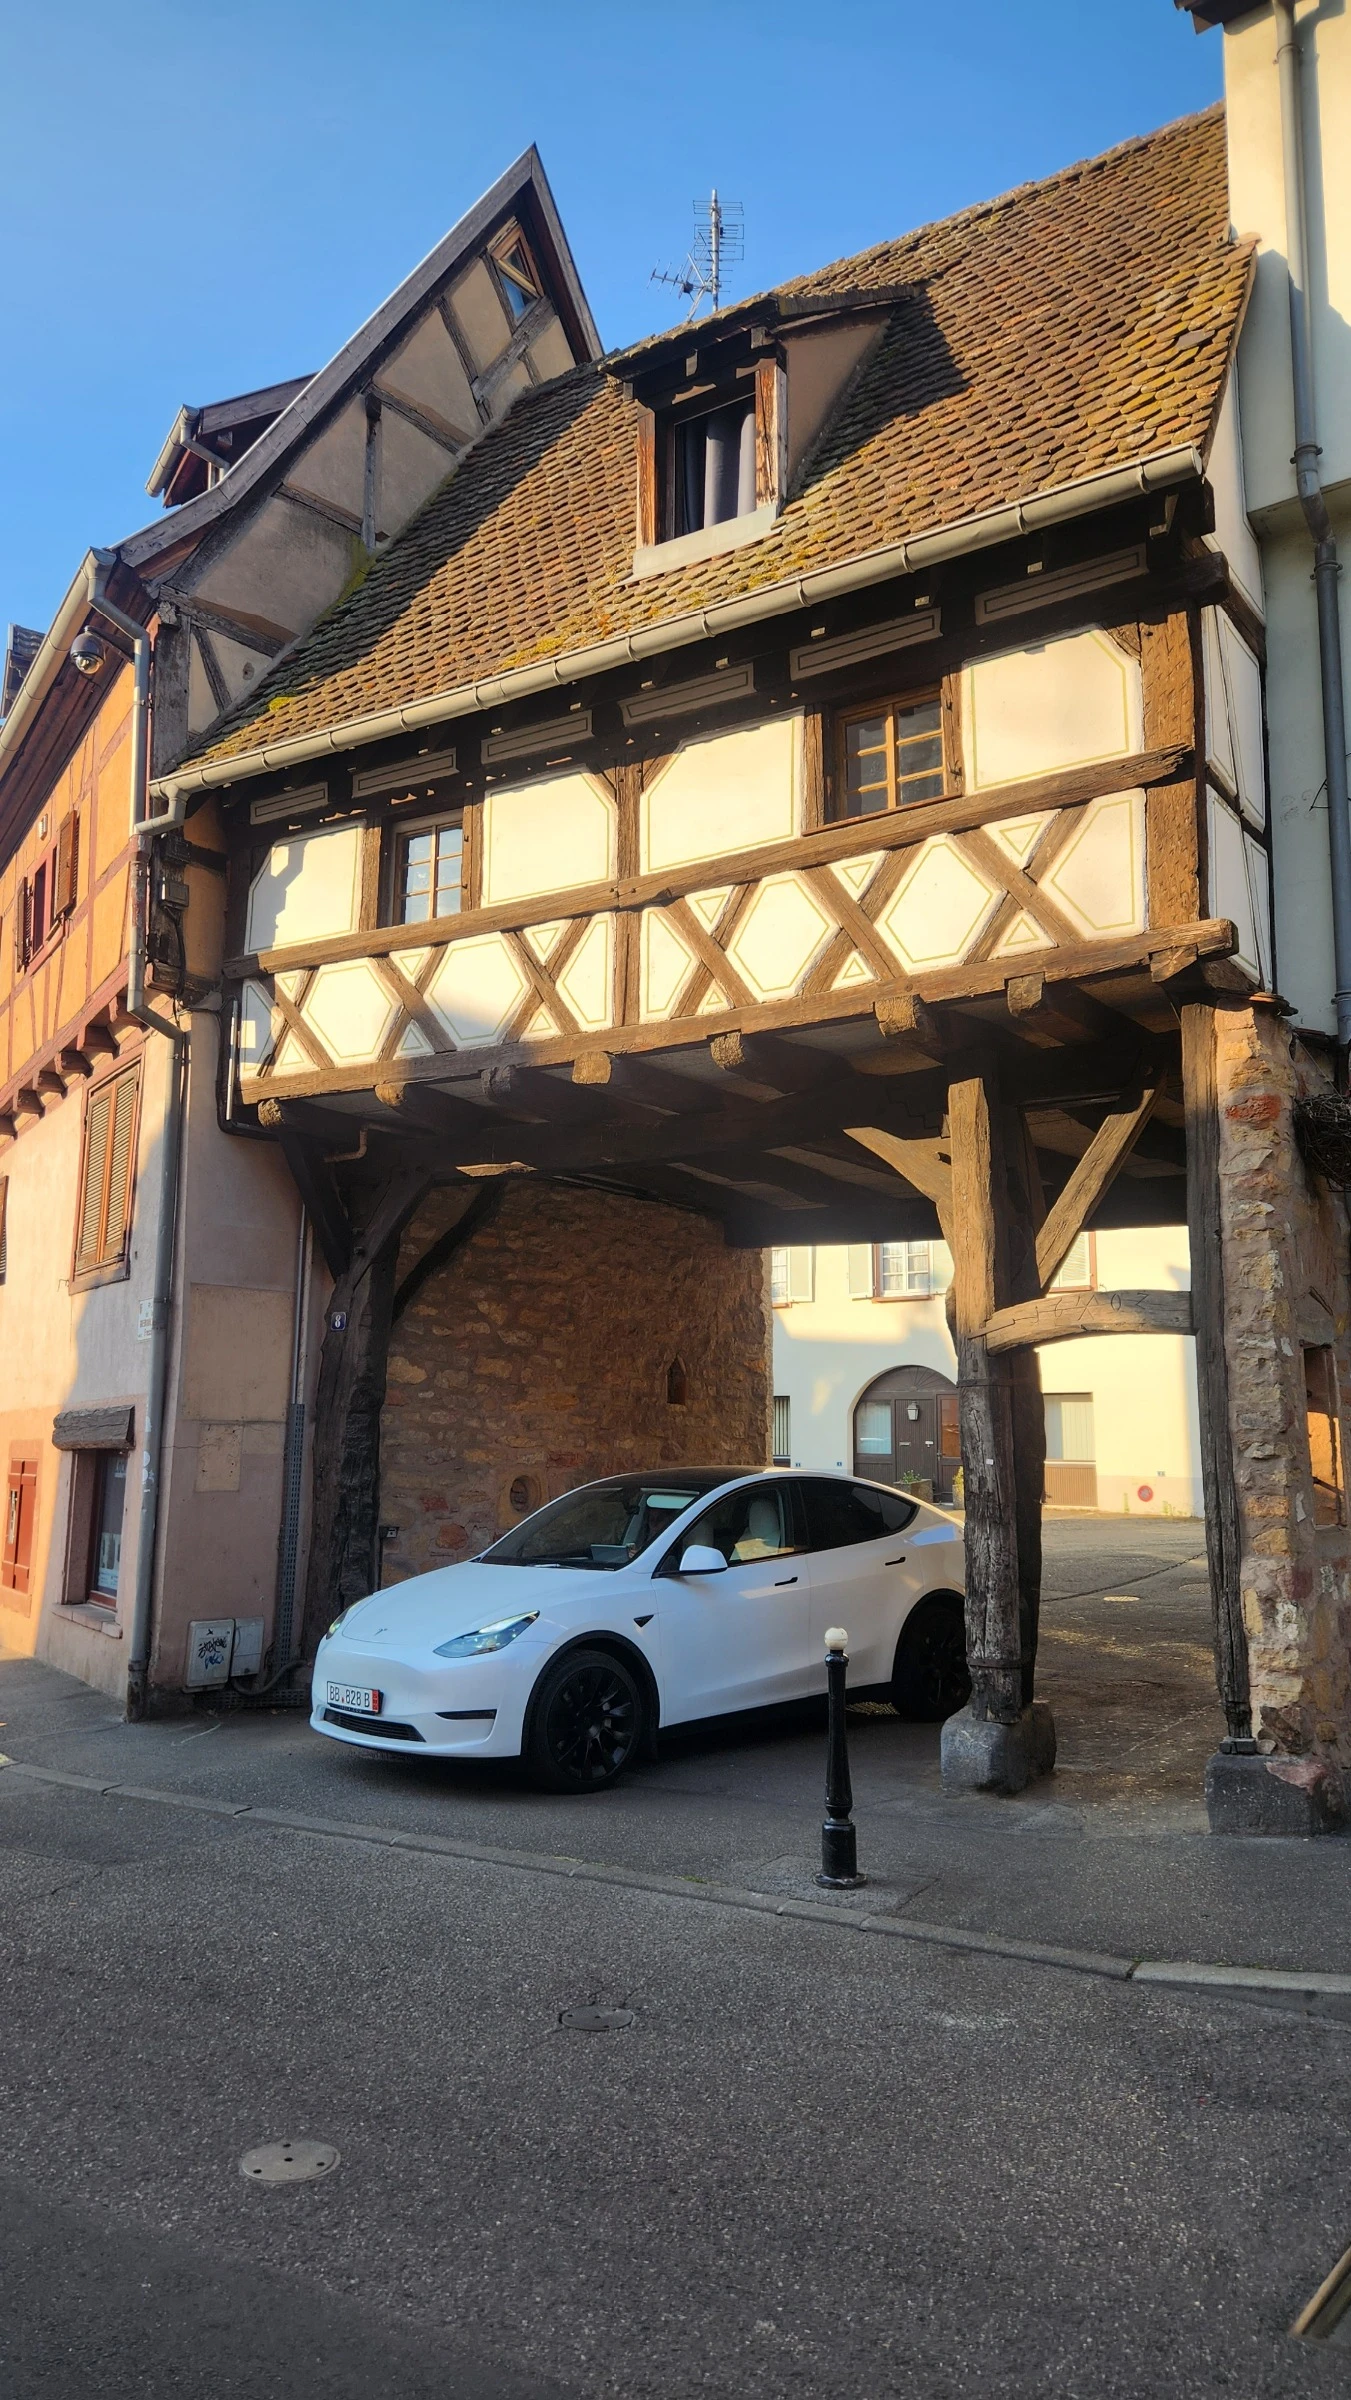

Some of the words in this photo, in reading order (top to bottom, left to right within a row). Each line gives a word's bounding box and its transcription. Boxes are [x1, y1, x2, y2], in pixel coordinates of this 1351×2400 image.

[334, 1314, 341, 1328] 8
[330, 1685, 340, 1701] BB
[345, 1688, 361, 1706] 828
[364, 1692, 370, 1708] B
